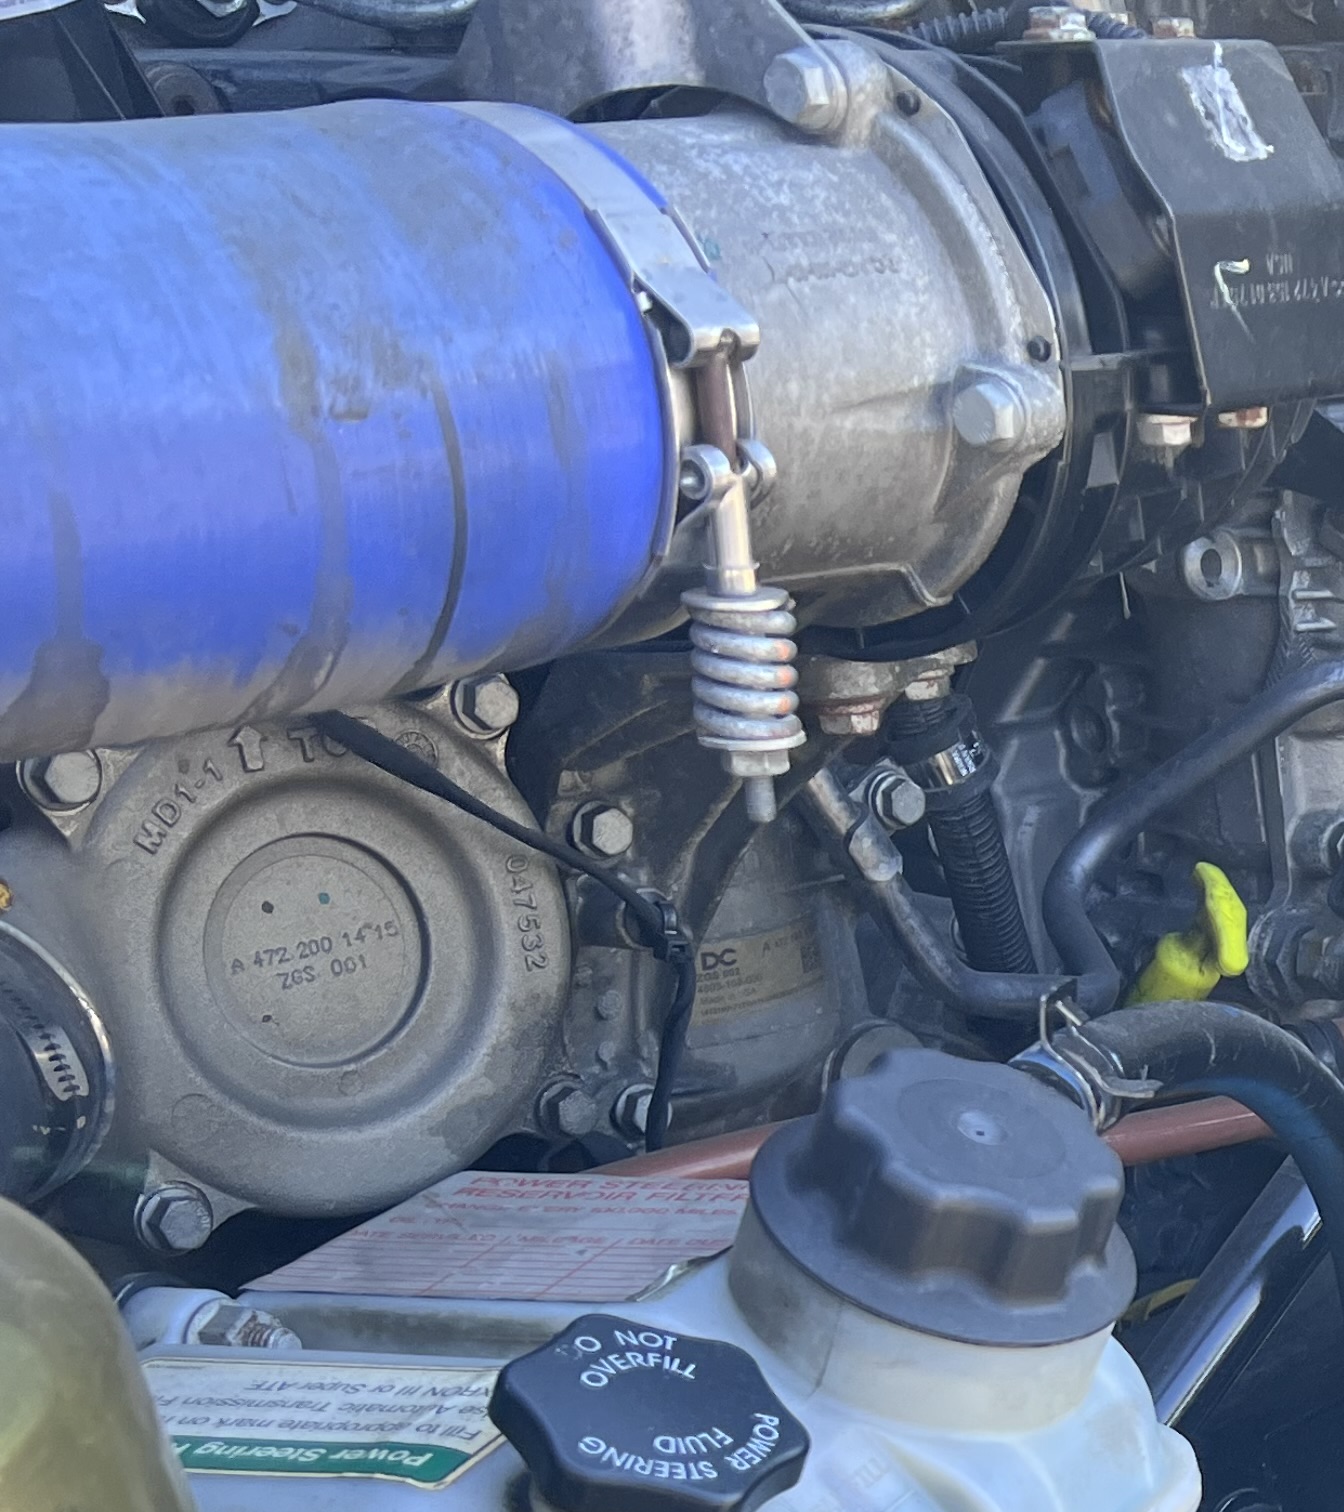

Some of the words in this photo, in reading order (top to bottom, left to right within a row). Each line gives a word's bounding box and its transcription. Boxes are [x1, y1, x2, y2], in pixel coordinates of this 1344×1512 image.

[505, 854, 549, 973] 047532
[231, 957, 245, 975] A
[253, 946, 293, 968] 472
[296, 936, 333, 960] 200
[700, 947, 738, 971] DC
[276, 965, 316, 990] ZGS
[330, 954, 367, 977] 001
[470, 1177, 592, 1189] POWER
[451, 1187, 638, 1201] RESERVOIR
[613, 1330, 678, 1351] NOT
[579, 1351, 697, 1388] OVERFILL
[298, 1381, 367, 1395] Super
[366, 1383, 396, 1394] or
[181, 1396, 332, 1413] Transmission
[337, 1401, 457, 1415] Automatic
[177, 1415, 211, 1426] on
[212, 1417, 276, 1429] mark
[276, 1418, 413, 1435] appropriate
[415, 1422, 441, 1435] to
[439, 1424, 483, 1441] Fill
[652, 1426, 735, 1455] FLUID
[724, 1412, 781, 1472] POWER
[192, 1441, 328, 1462] Steering
[327, 1448, 435, 1467] Power
[577, 1436, 719, 1480] STEERING
